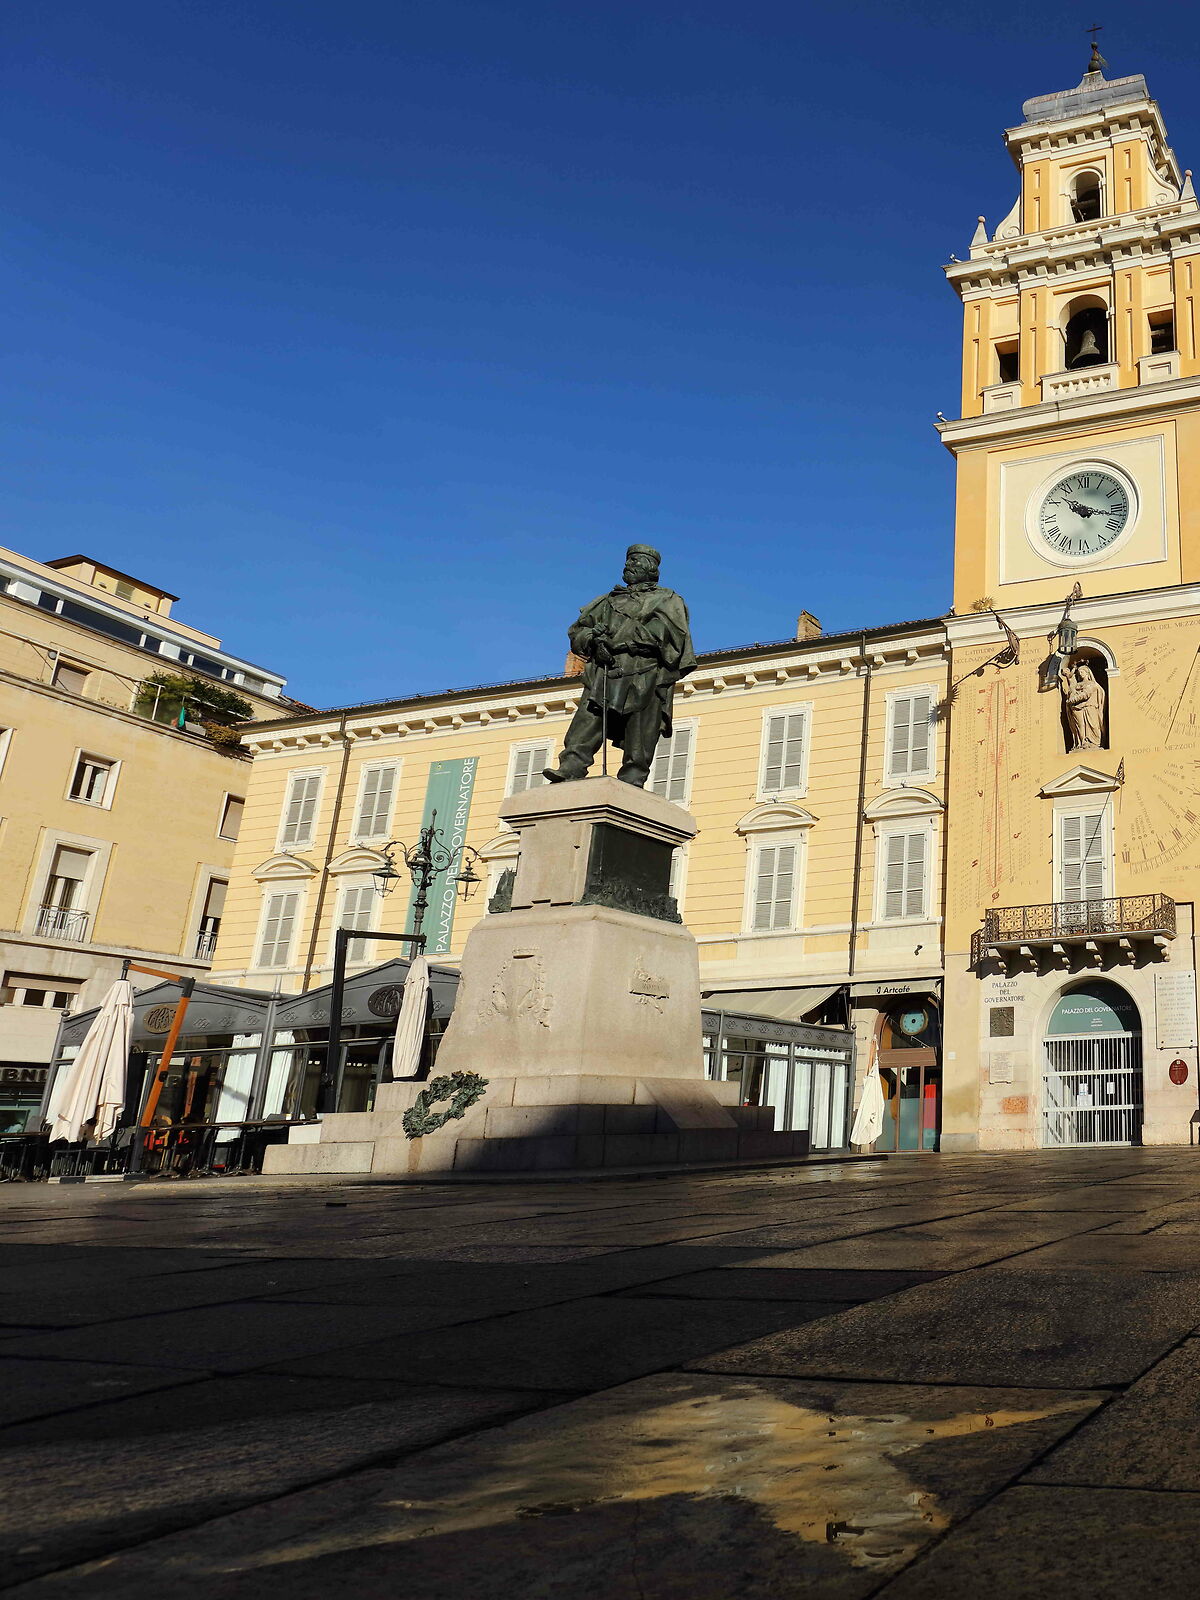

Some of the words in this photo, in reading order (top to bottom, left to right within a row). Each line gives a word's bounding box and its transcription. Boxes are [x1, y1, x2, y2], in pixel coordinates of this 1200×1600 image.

[1078, 476, 1090, 489] XII
[1060, 483, 1073, 496] XI
[1106, 488, 1117, 498] II
[1048, 498, 1061, 507] X
[1044, 514, 1056, 524] IX
[1105, 518, 1120, 531] IIII
[1047, 526, 1061, 542] VIII
[1097, 534, 1106, 545] V
[1059, 536, 1072, 550] VII
[1079, 539, 1090, 551] VI
[436, 889, 454, 952] PALAZZO
[446, 862, 458, 885] DEL
[883, 985, 910, 994] Artcafé
